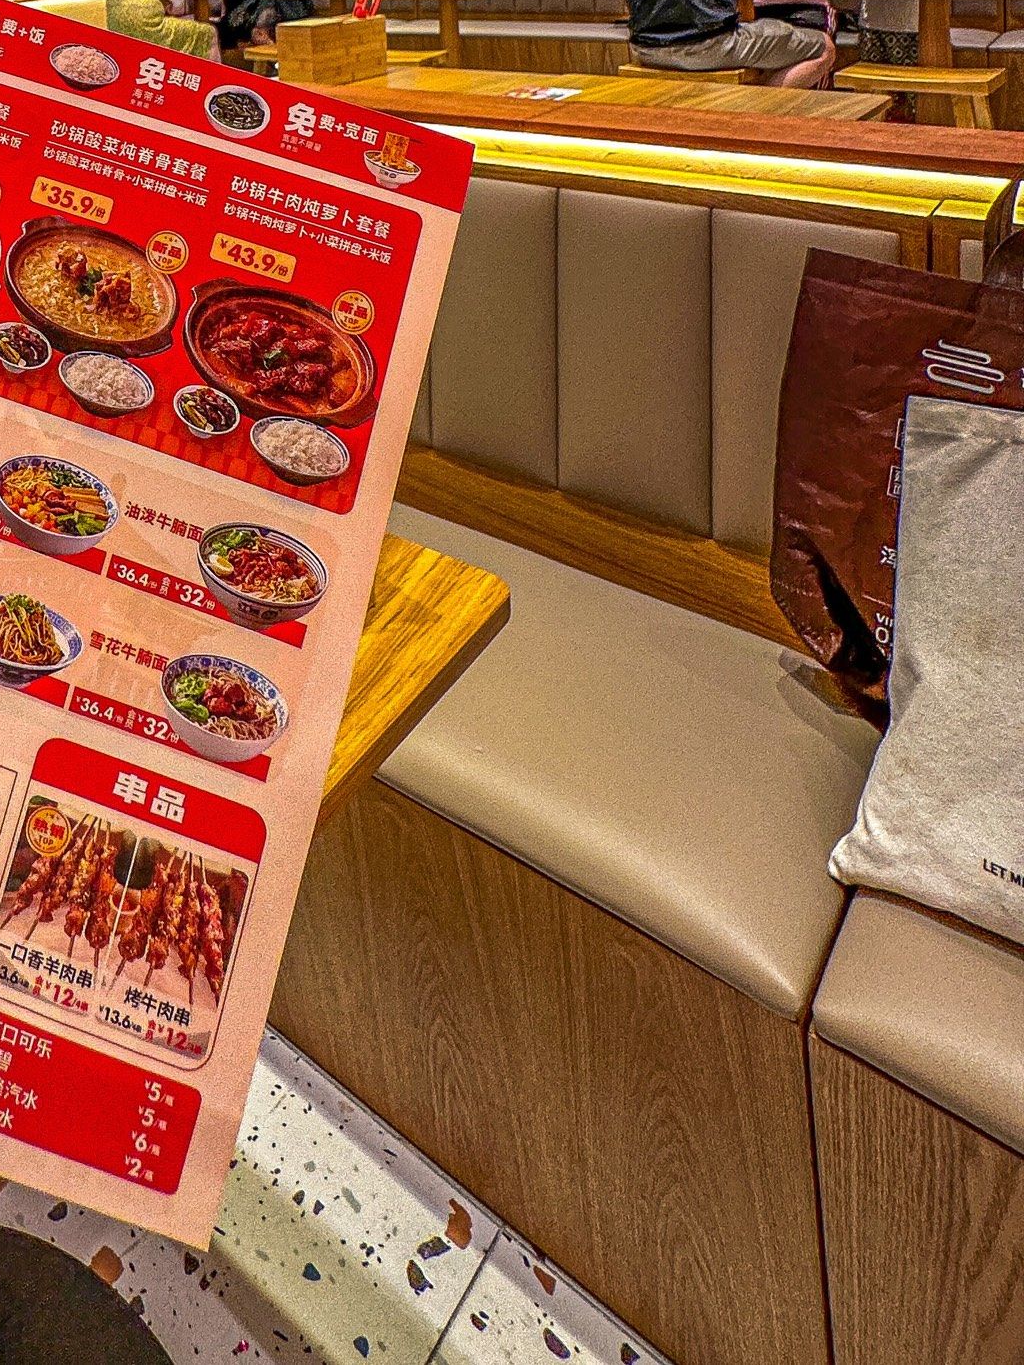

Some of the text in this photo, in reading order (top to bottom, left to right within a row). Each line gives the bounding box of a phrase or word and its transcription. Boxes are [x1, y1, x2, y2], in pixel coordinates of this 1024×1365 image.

[134, 55, 202, 93] 免费喝
[283, 100, 379, 147] 免费+宽面
[49, 118, 208, 183] 砂锅酸菜炖脊骨套餐
[37, 181, 107, 220] ¥35.9/份
[229, 174, 392, 241] 砂锅牛肉炖萝卜套餐
[151, 239, 182, 260] 新品
[216, 238, 290, 278] ¥43.9/份
[337, 299, 369, 320] 新品
[124, 501, 204, 543] 油泼牛腩面
[88, 629, 168, 673] 雪花牛腩面
[111, 769, 189, 824] 串品
[983, 858, 1007, 879] LET
[123, 986, 192, 1028] 烤牛肉串
